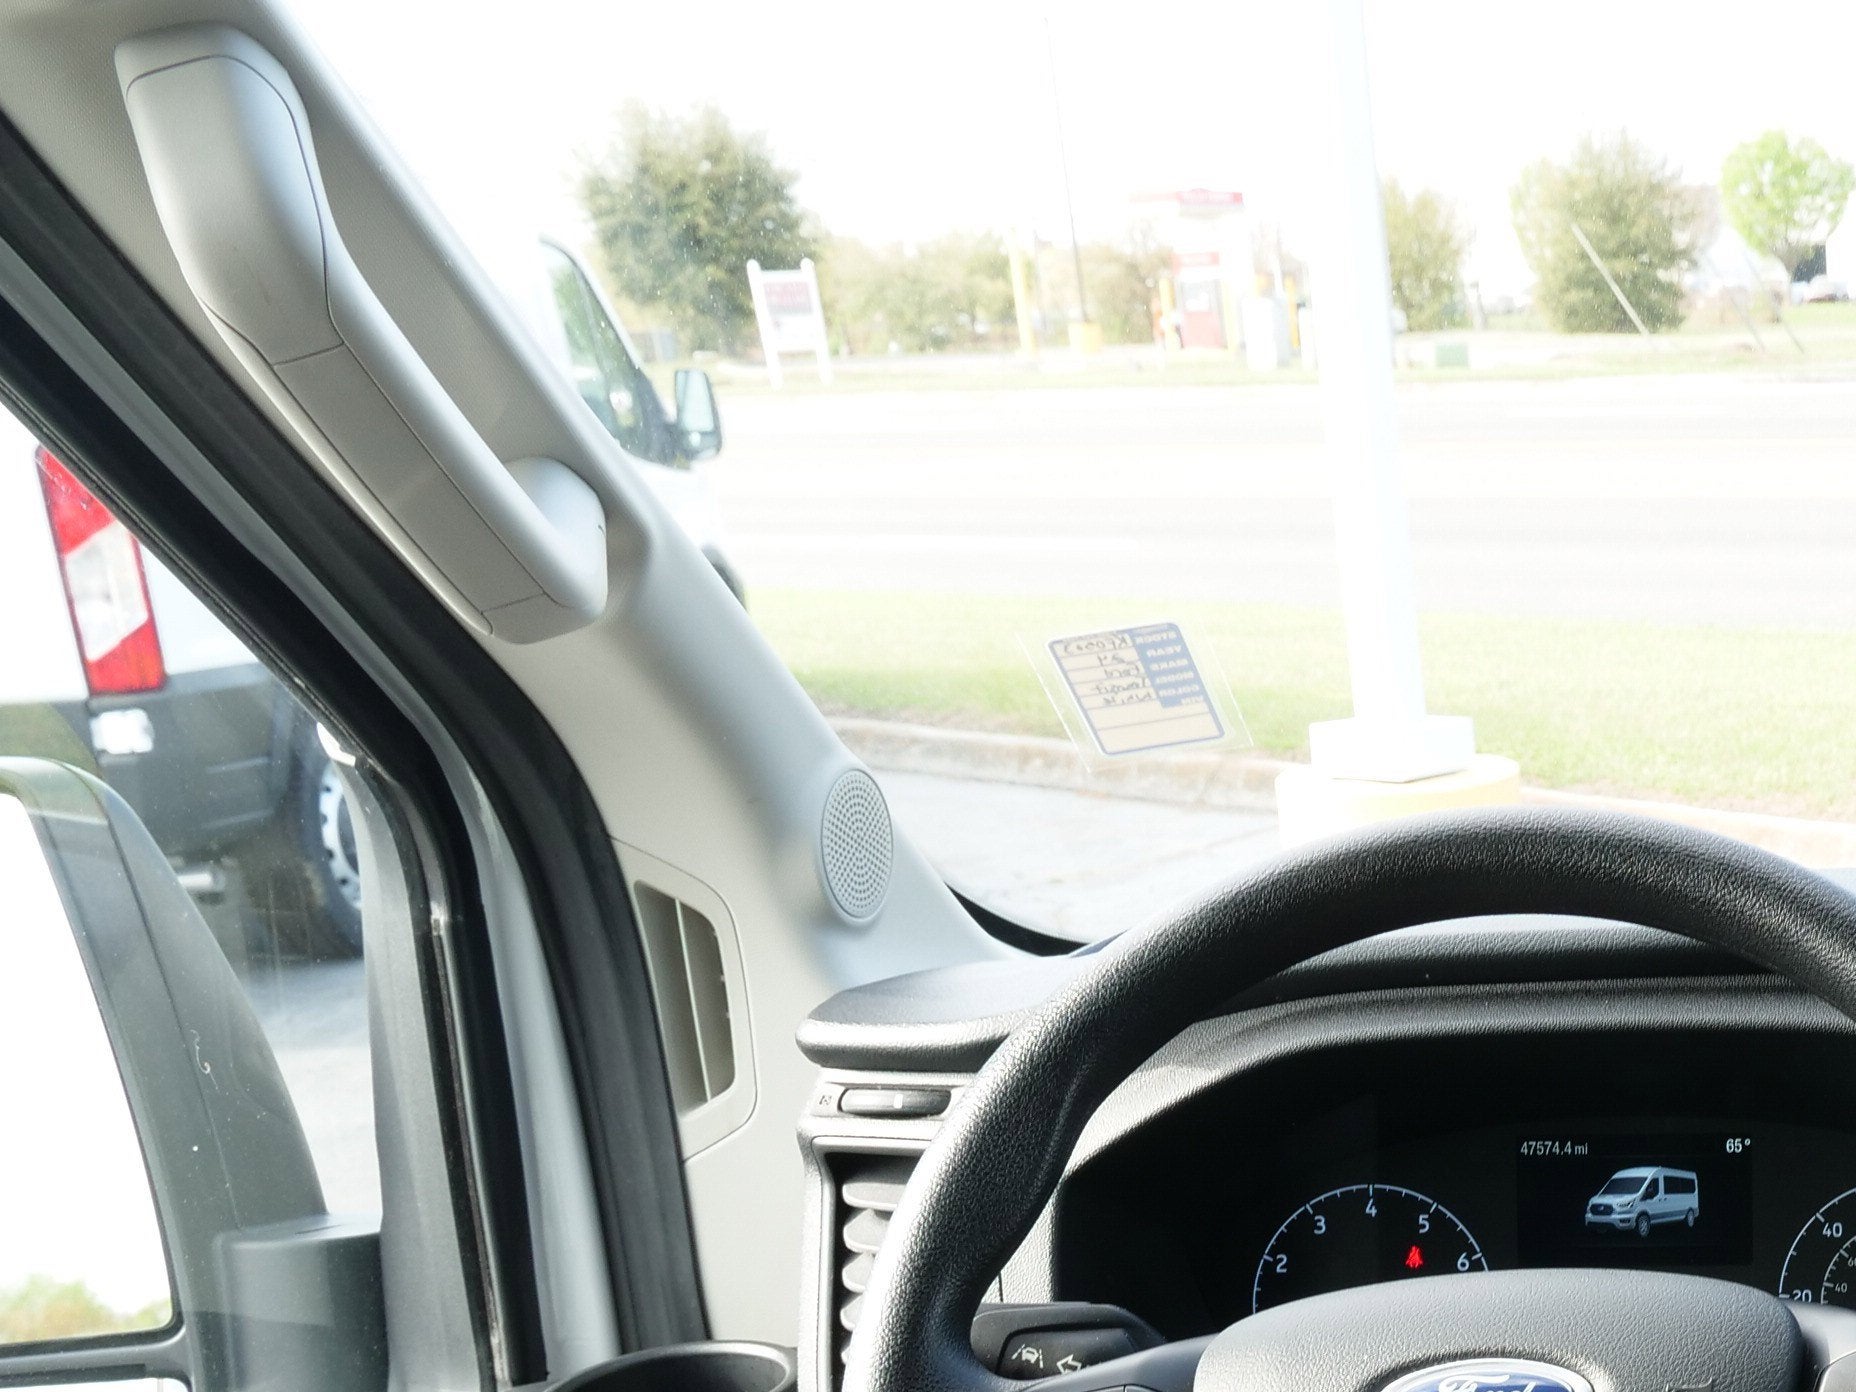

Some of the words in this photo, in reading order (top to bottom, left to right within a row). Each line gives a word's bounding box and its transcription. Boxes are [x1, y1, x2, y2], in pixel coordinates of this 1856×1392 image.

[1520, 1140, 1572, 1156] 47574.4
[1574, 1141, 1588, 1156] mi
[1365, 1199, 1378, 1217] 4
[1313, 1214, 1326, 1235] 3
[1418, 1214, 1430, 1234] 5
[1822, 1222, 1843, 1238] 40
[1275, 1254, 1288, 1273] 2
[1456, 1251, 1470, 1272] 6
[1792, 1288, 1812, 1303] 20
[1835, 1282, 1848, 1293] 40
